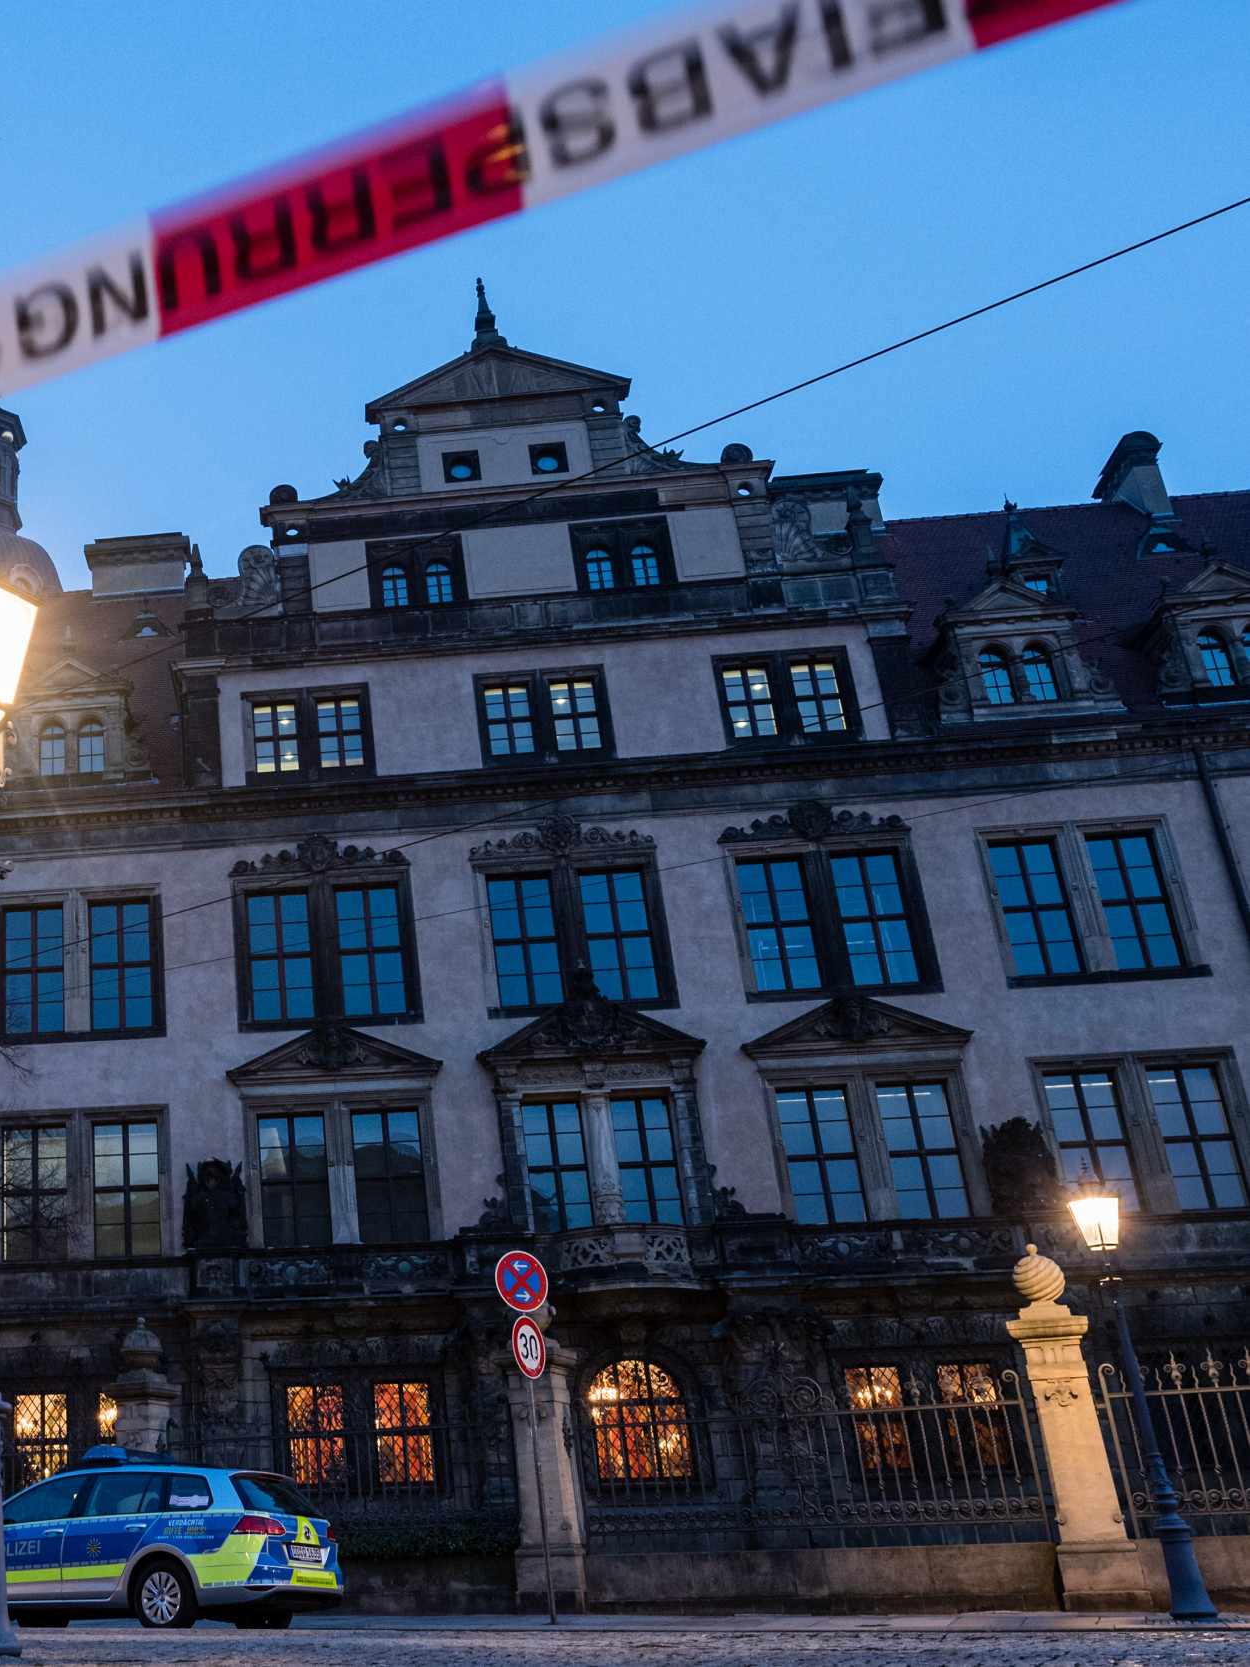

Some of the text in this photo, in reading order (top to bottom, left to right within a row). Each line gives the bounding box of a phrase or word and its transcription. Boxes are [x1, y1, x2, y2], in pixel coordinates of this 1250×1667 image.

[14, 0, 972, 360] EIABSPERRUNG
[519, 1332, 538, 1361] 30
[6, 1539, 41, 1557] LIZEI
